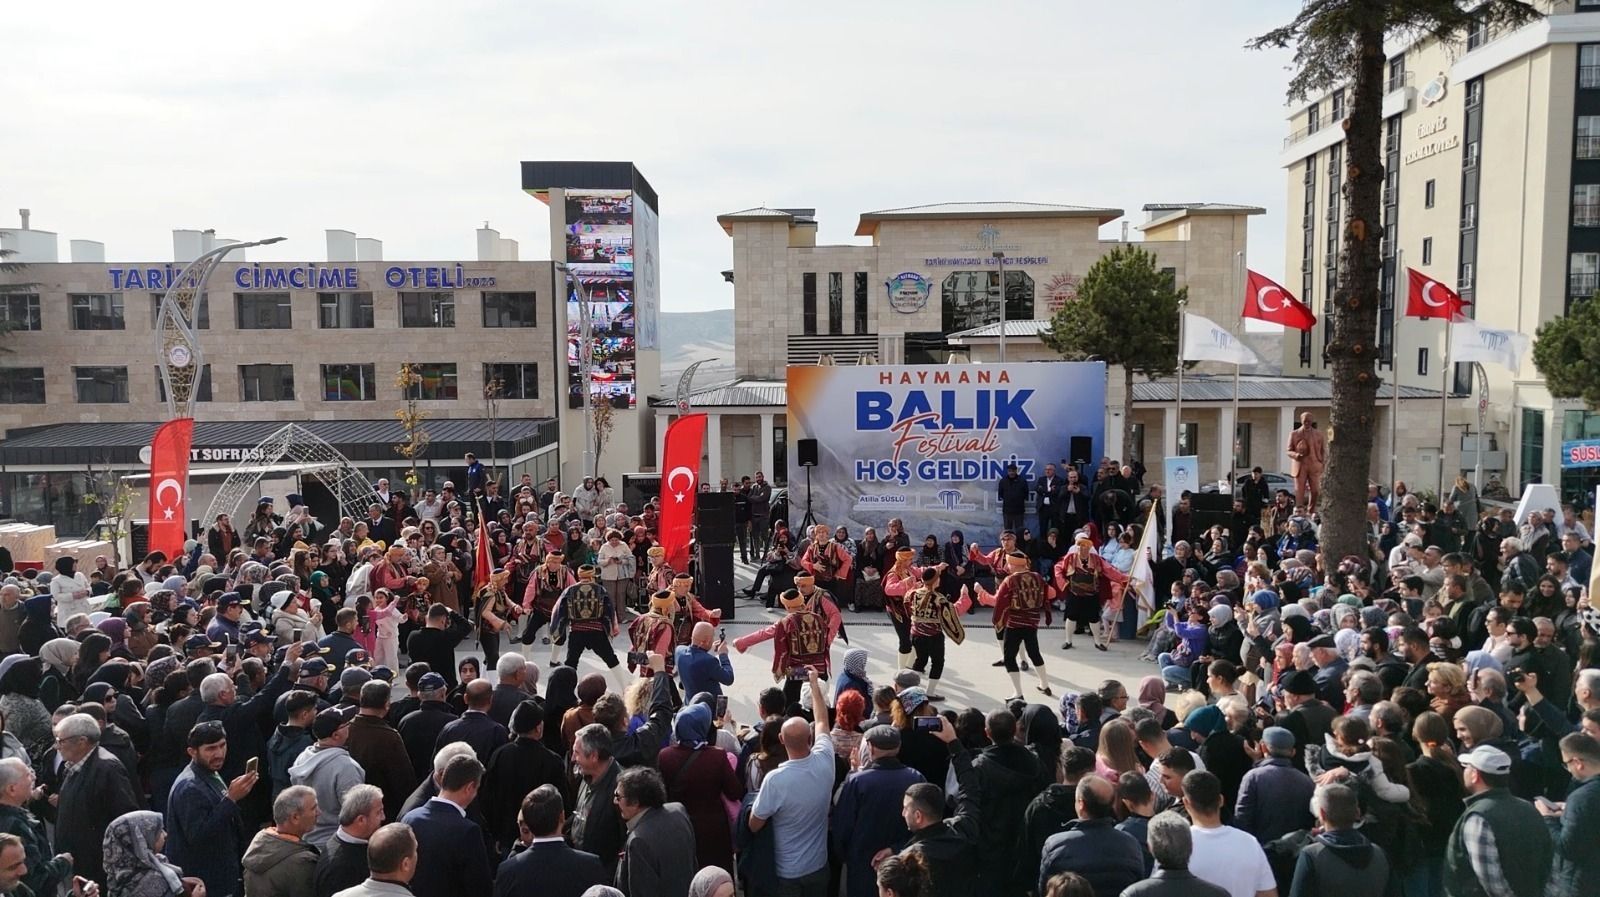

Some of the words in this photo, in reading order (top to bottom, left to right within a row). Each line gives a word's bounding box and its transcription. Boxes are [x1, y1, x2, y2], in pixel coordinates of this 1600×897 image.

[235, 263, 358, 289] CİMCİME
[385, 263, 464, 289] OTELİ
[879, 370, 1011, 385] HAYMANA
[856, 389, 1036, 431] BALIK
[891, 412, 1001, 468] Festivali
[856, 460, 911, 484] HOŞ
